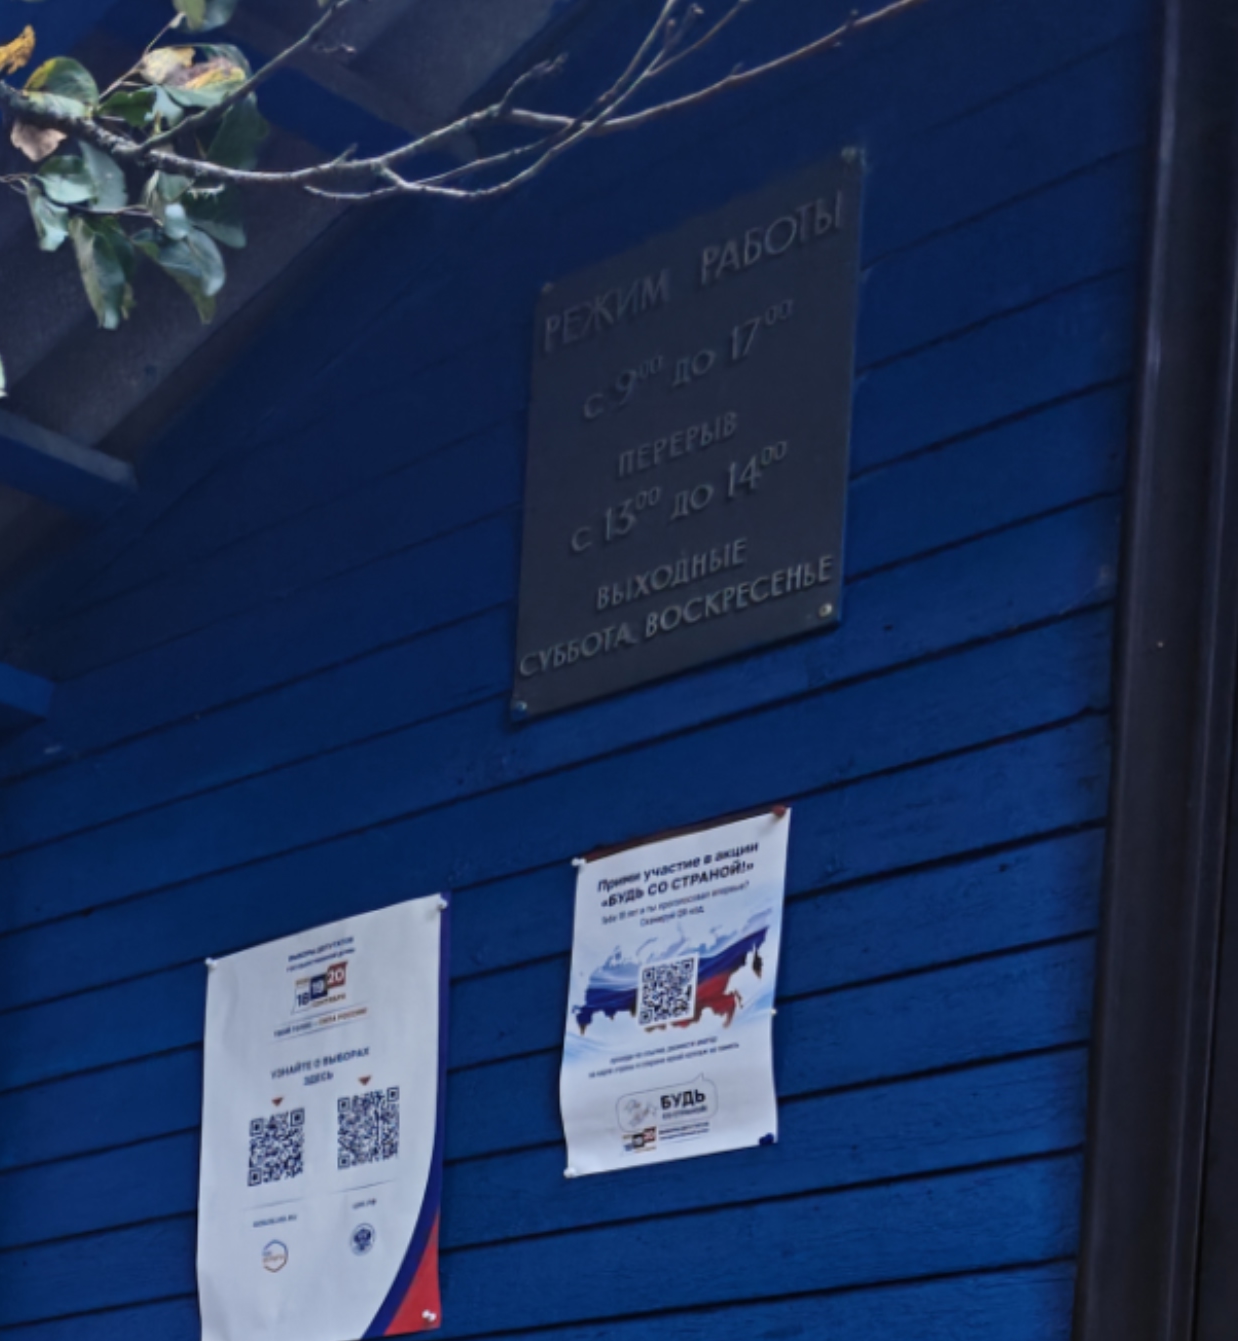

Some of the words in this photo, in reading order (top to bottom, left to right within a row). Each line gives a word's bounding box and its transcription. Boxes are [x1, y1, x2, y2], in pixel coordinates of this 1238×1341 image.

[543, 268, 670, 353] РЕЖИМ
[701, 189, 842, 286] РАБОТЫ
[618, 411, 738, 478] ПЕРЕРЫВ
[597, 537, 747, 610] ВЫХОДНЫЕ
[645, 555, 833, 639] ВОСКРЕСЕНЬЕ
[597, 872, 641, 893] Прими
[643, 856, 701, 882] участие
[703, 854, 713, 865] в
[714, 842, 759, 862] акции
[647, 881, 669, 897] СО
[327, 969, 344, 984] 20
[271, 1059, 311, 1079] УЗНАЙТЕ
[313, 1058, 321, 1069] О
[322, 1047, 370, 1068] ВЫБОРАХ
[303, 1070, 334, 1086] ЗДЕСЬ
[660, 1089, 706, 1110] БУДЬ
